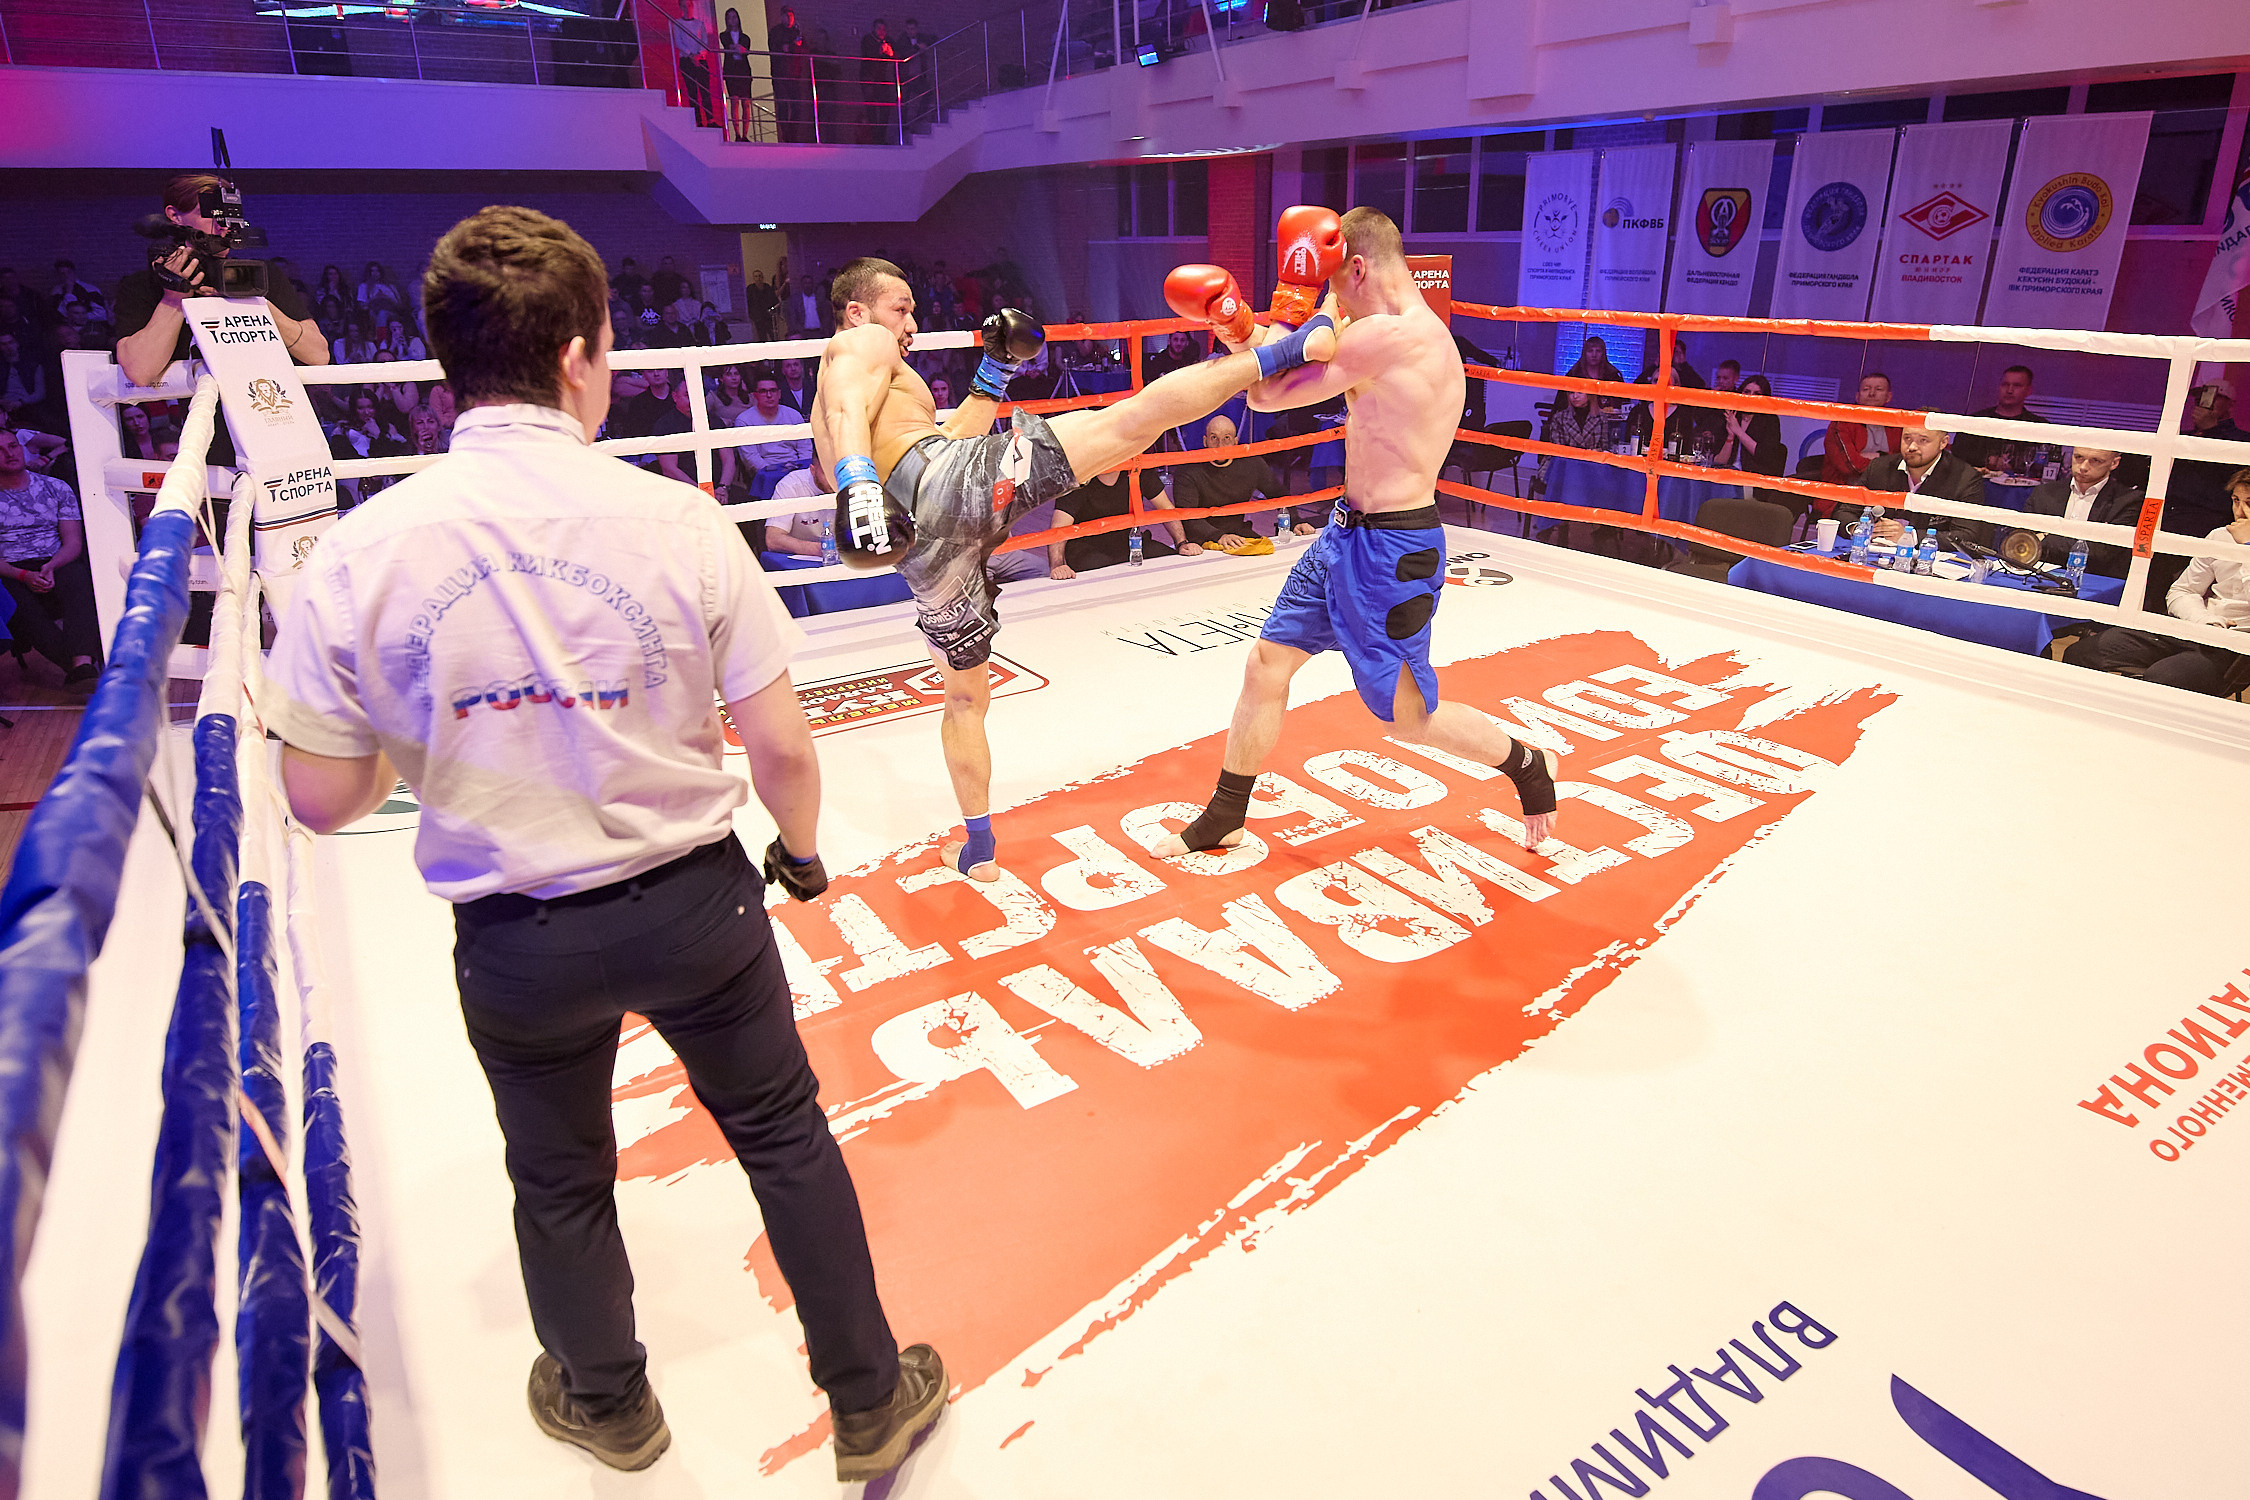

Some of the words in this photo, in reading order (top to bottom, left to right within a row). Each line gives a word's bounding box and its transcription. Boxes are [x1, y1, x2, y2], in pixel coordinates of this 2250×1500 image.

[2033, 176, 2078, 209] Kyokushin
[2081, 176, 2103, 195] Budo
[2099, 191, 2109, 209] Kai
[1538, 192, 1578, 213] PRIMORYE
[1622, 218, 1665, 229] ПКФВБ
[2030, 223, 2064, 249] Applied
[2069, 224, 2102, 249] Karate
[1899, 254, 1974, 265] СПАРТАК
[1413, 269, 1450, 279] АРЕНА
[1788, 272, 1827, 280] ФЕДЕРАЦИЯ
[1901, 274, 1963, 284] ВЛАДИВОСТОК
[2018, 267, 2070, 275] ФЕДЕРАЦИЯ
[2070, 268, 2099, 276] КАРАТЭ
[1414, 279, 1450, 290] ПОРТА
[2017, 276, 2054, 284] КЕКУСИН
[2055, 277, 2092, 286] БУДОКАЙ
[2022, 285, 2081, 294] ПРИМОРСКОГО
[2081, 288, 2103, 296] КРАЯ
[224, 315, 273, 328] АРЕНА
[220, 329, 279, 344] СПОРТА
[1649, 434, 1662, 467] SPARTA
[287, 466, 333, 485] АРЕНА
[2045, 468, 2055, 477] 17
[279, 480, 334, 502] СПОРТА
[848, 484, 872, 550] HILL
[867, 482, 893, 556] GREEN
[2142, 501, 2160, 542] SPARTA
[507, 550, 667, 690] КИКБОКСИНГА
[809, 698, 923, 726] МЕБЕЛЬ
[1529, 1300, 1838, 1500] ВЛАДИМ
